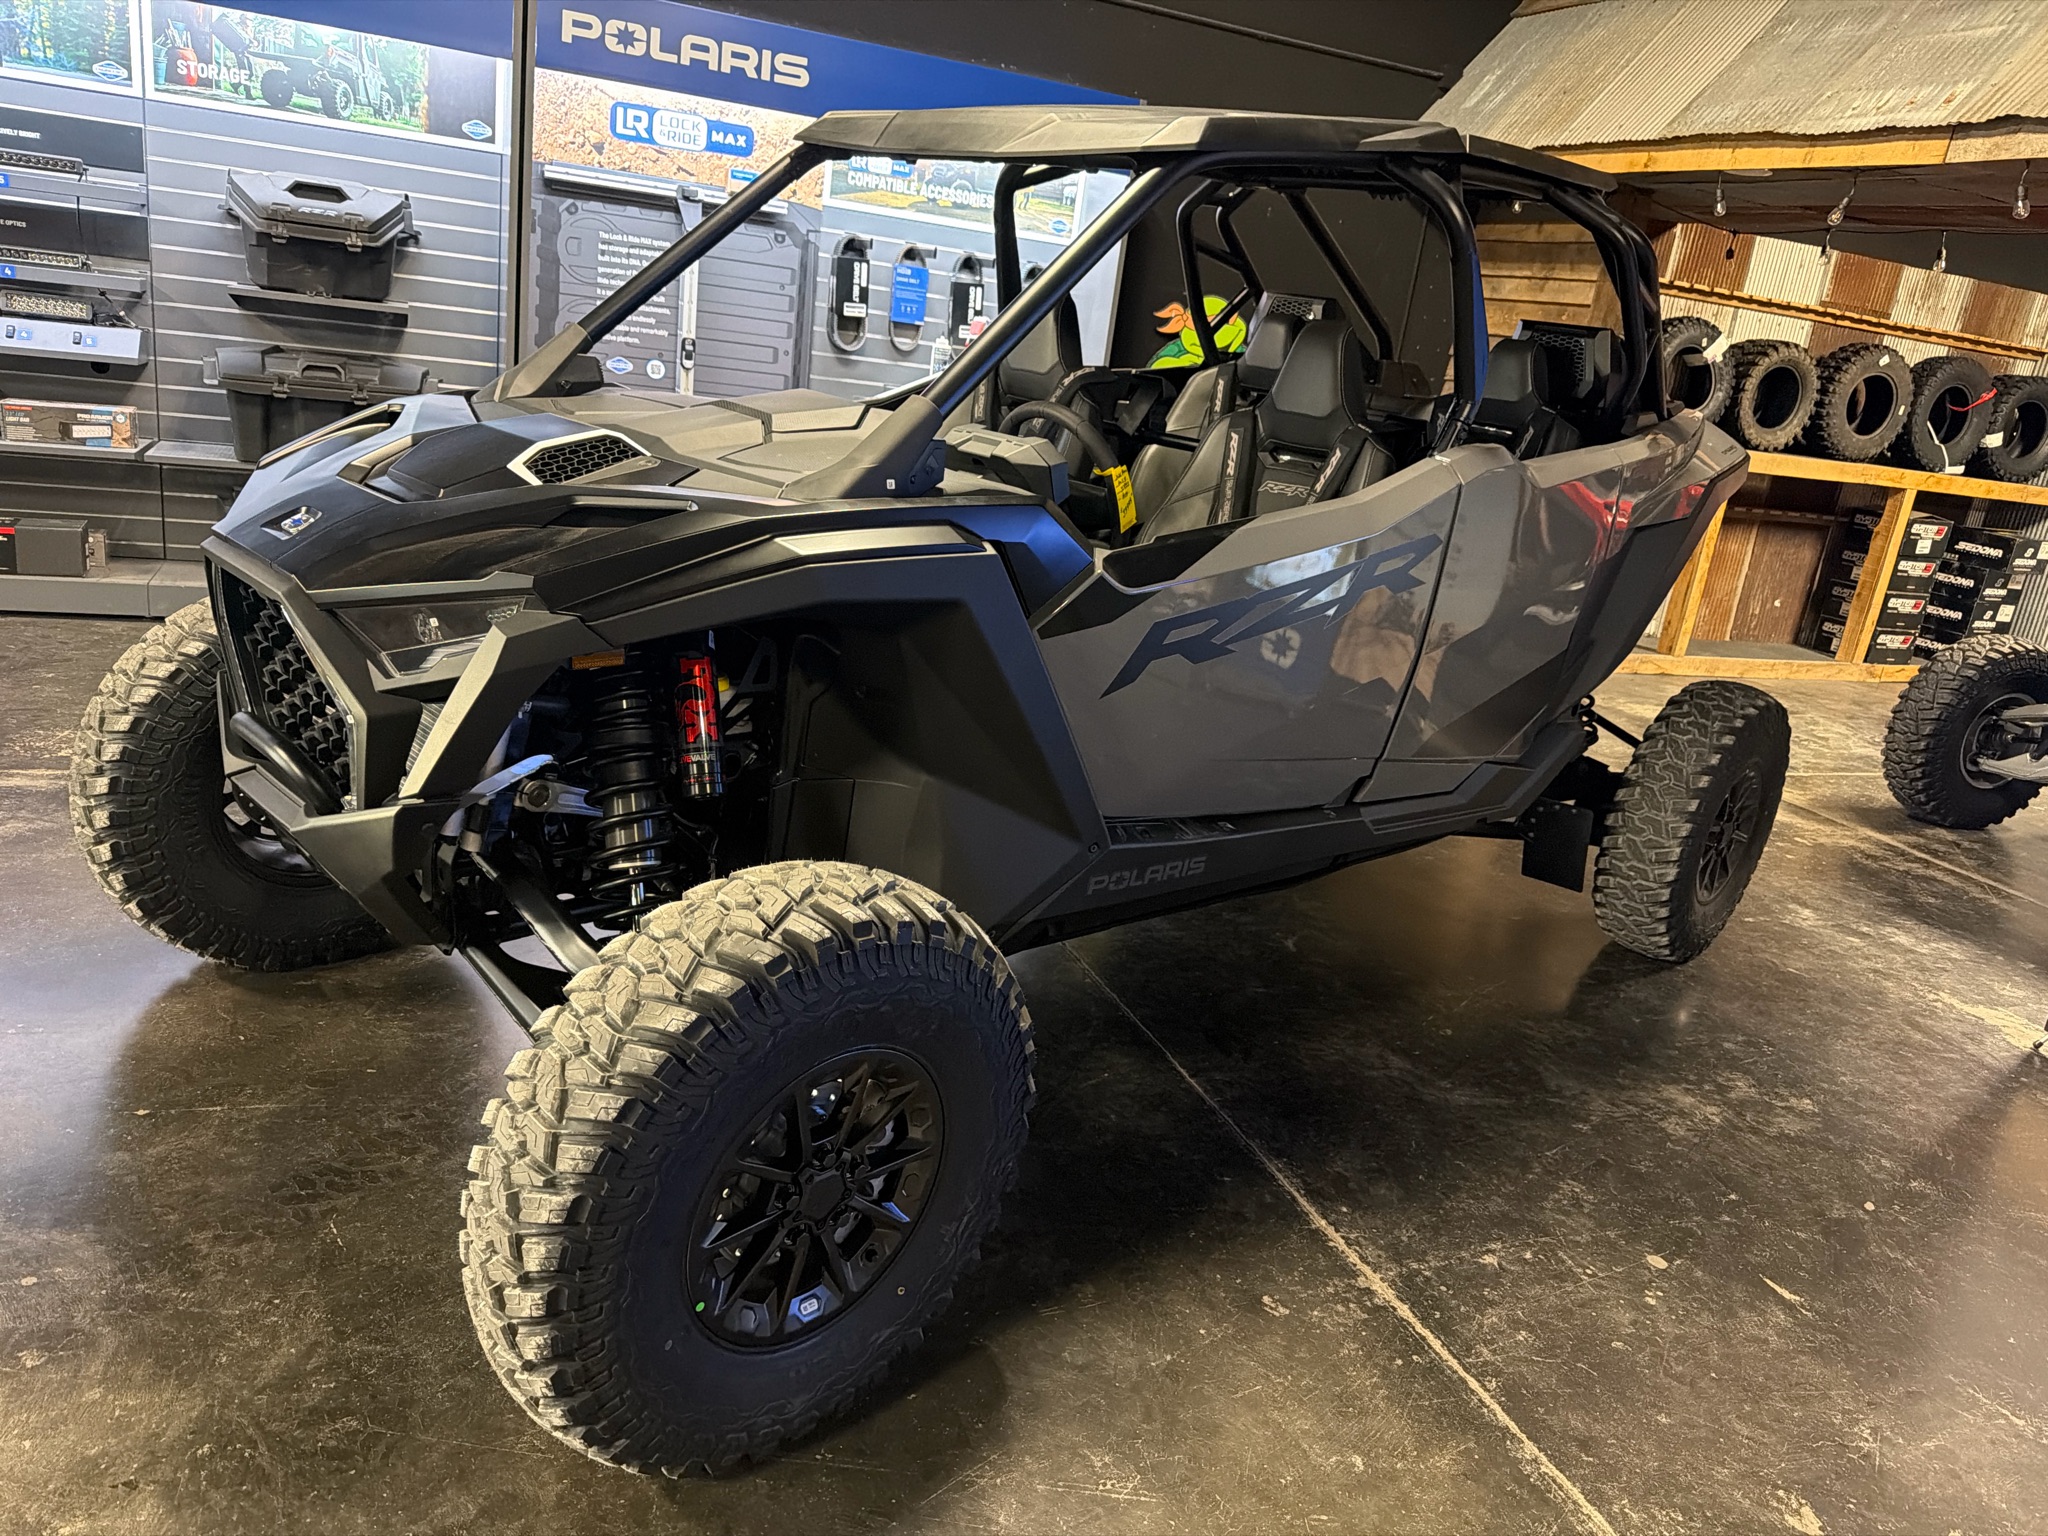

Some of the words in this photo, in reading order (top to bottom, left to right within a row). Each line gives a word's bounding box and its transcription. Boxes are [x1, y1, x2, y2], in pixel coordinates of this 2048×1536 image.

[561, 9, 810, 88] POLARIS
[176, 59, 251, 85] STORAGE
[615, 106, 650, 139] LR
[660, 116, 701, 132] LOCK
[711, 129, 747, 148] MAX
[848, 170, 918, 196] COMPATIBLE
[920, 184, 994, 209] ACCESSORIES
[5, 219, 27, 228] OPTICS
[598, 230, 610, 240] The
[1227, 431, 1239, 477] RZR
[1314, 447, 1342, 493] RZR
[1258, 480, 1311, 498] RZR
[1953, 540, 2004, 558] SEDONA
[1099, 534, 1444, 699] RZR
[1926, 604, 1963, 621] EDONA
[674, 656, 718, 743] FOX
[1086, 856, 1207, 896] POLARIS
